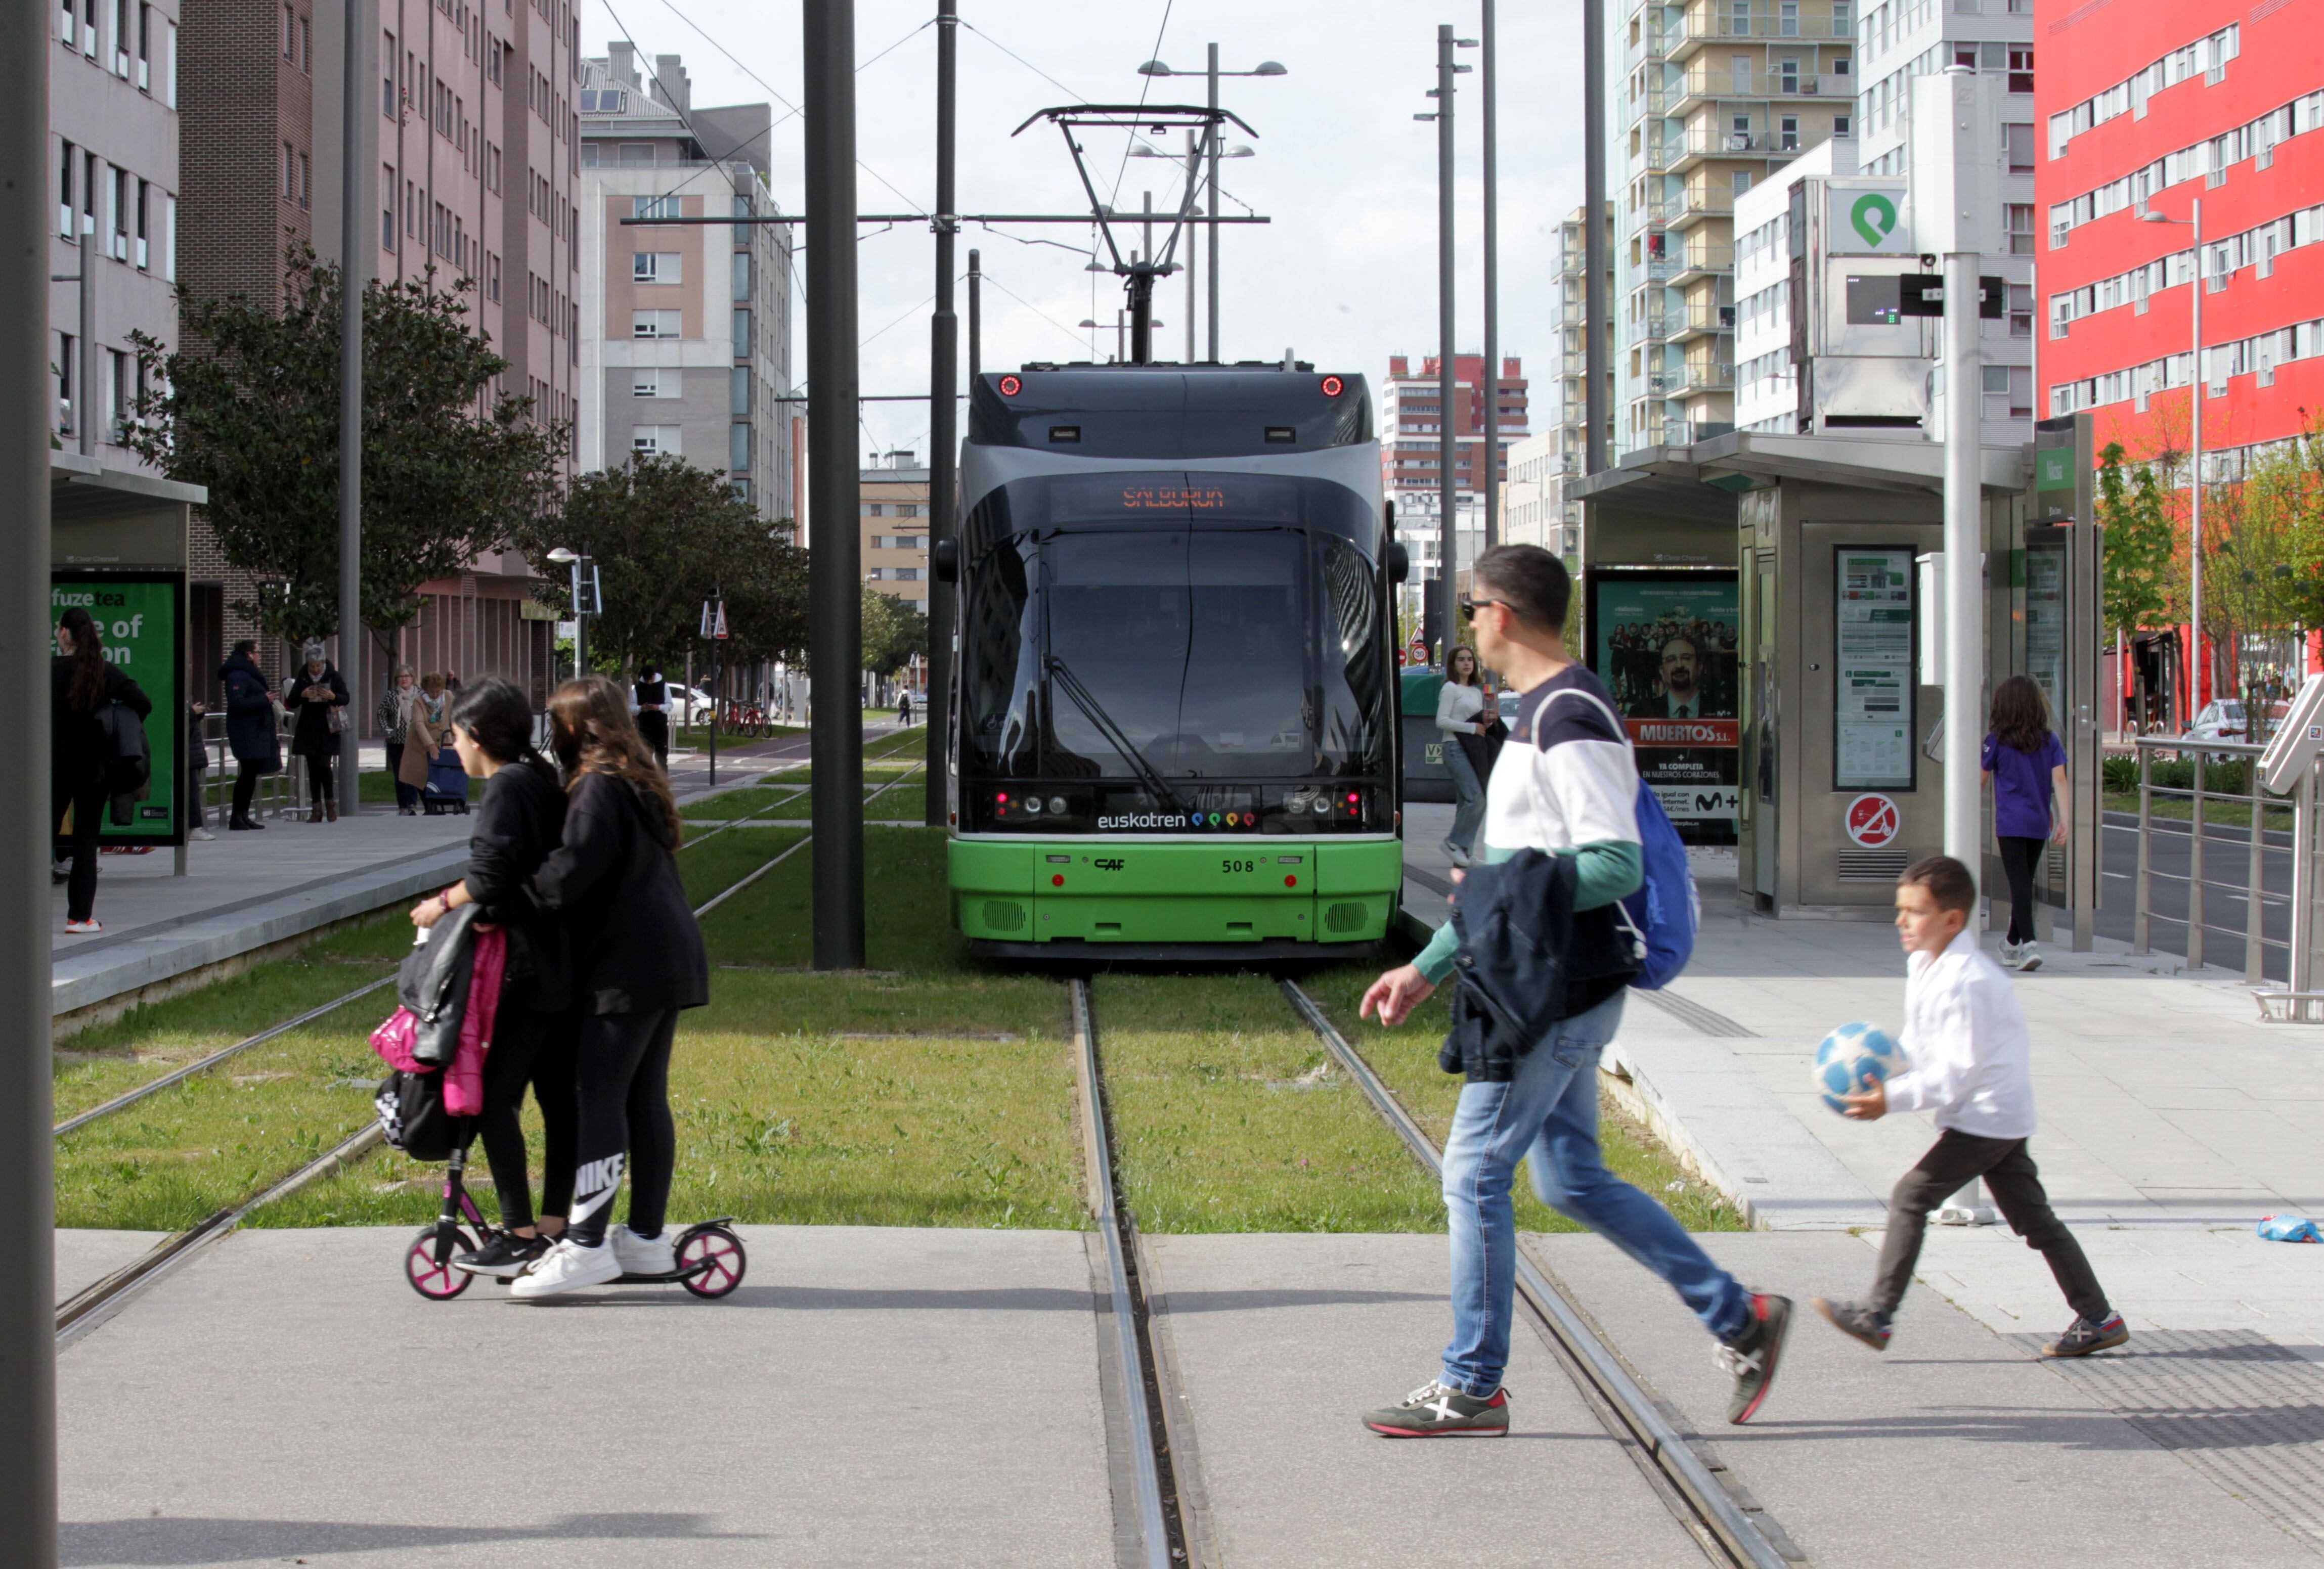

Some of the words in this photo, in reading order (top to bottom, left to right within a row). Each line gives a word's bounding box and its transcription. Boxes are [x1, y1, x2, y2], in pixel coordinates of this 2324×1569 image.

[1123, 486, 1223, 507] SALBURUA
[112, 614, 143, 638] of
[1640, 725, 1715, 742] MUERTOS
[1717, 733, 1730, 741] S.L.
[1098, 812, 1186, 828] euskotren
[1094, 859, 1125, 871] CAF
[1222, 860, 1254, 873] 508
[574, 1152, 625, 1199] NIKE
